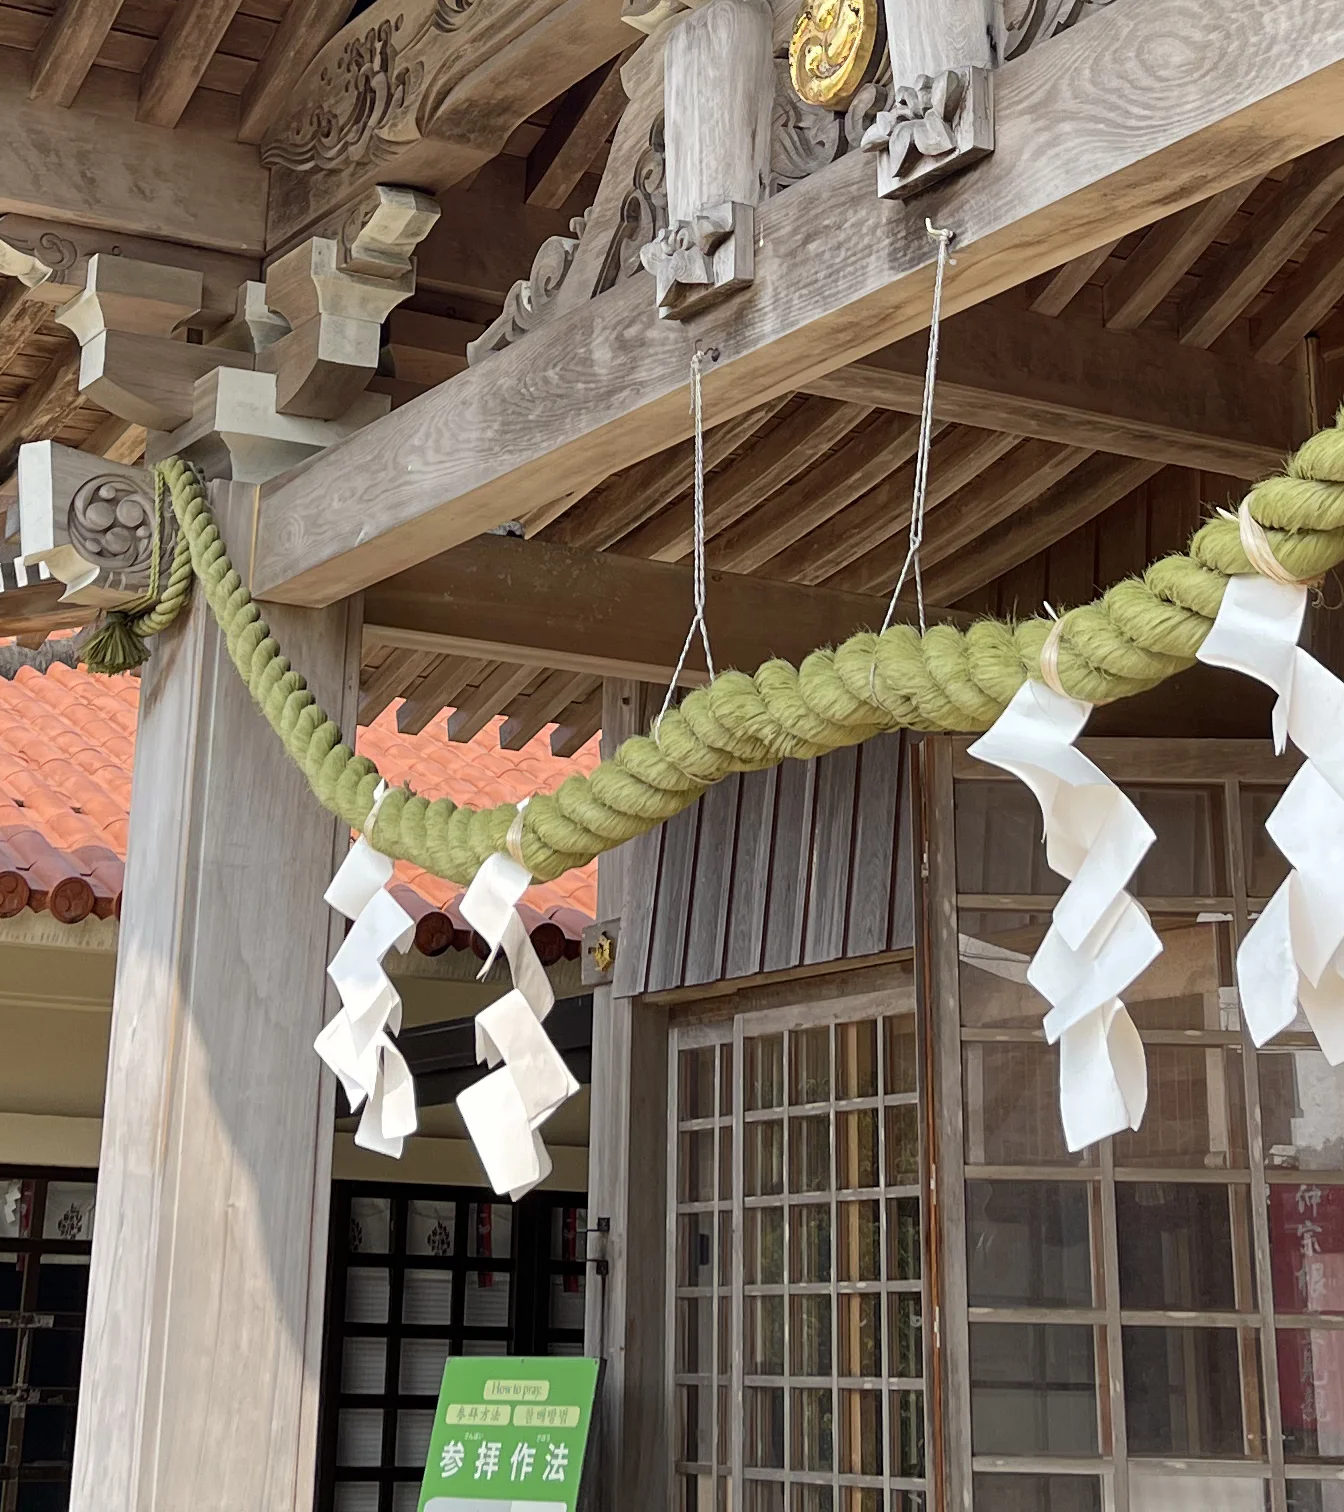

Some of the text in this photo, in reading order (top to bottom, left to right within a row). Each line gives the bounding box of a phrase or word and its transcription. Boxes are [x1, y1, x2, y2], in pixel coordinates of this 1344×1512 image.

[491, 1381, 511, 1395] How
[512, 1383, 522, 1395] to
[440, 1440, 569, 1481] 参拝作法
